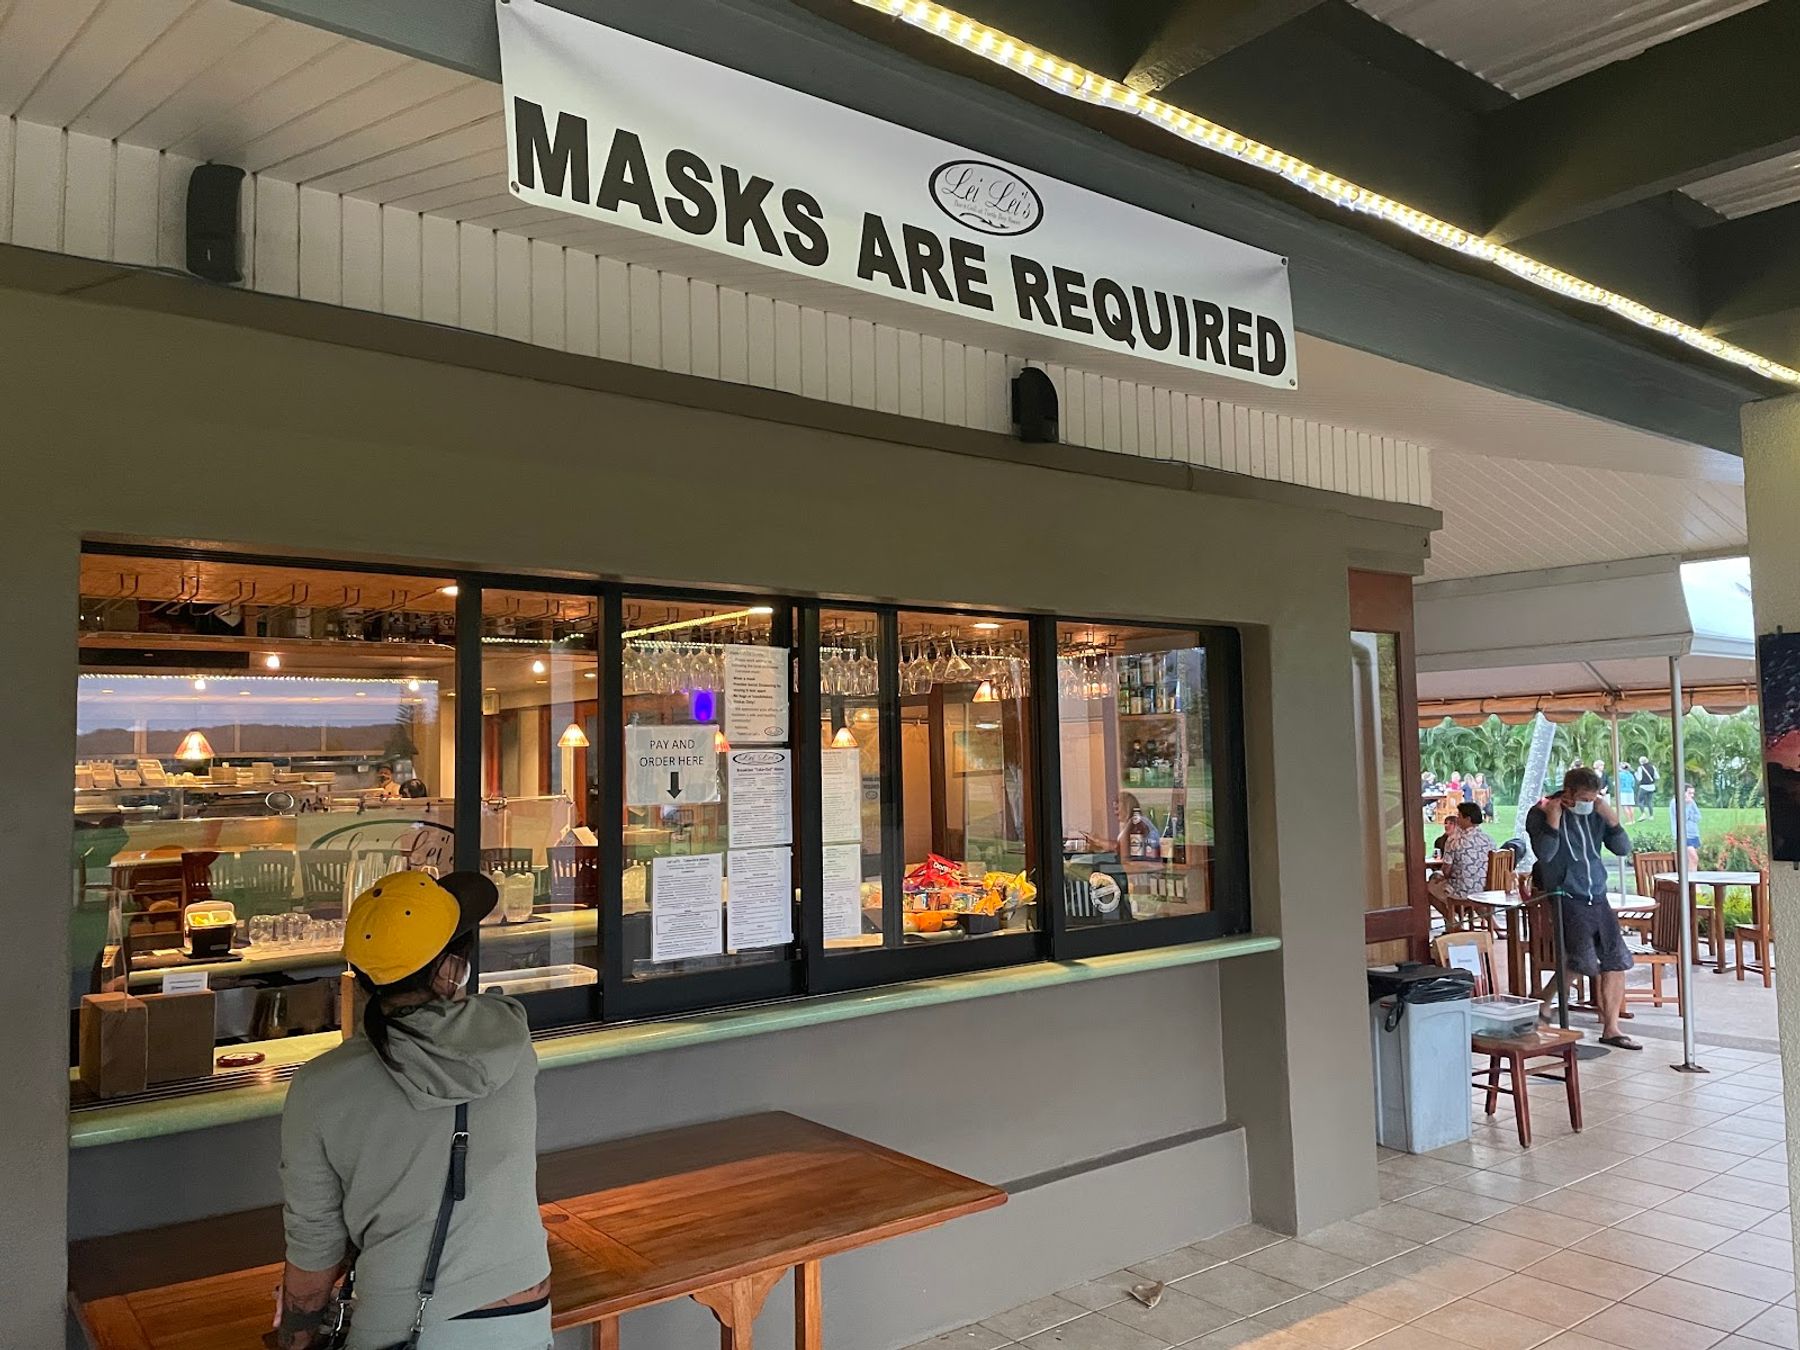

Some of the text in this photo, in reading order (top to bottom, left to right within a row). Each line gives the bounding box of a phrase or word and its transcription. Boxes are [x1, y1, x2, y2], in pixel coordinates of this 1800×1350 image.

[942, 167, 983, 202] Lei
[985, 181, 1031, 220] Lei's
[514, 96, 1287, 377] MASKS ARE REQUIRED
[650, 739, 695, 749] PAY AND
[639, 756, 704, 767] ORDER HERE
